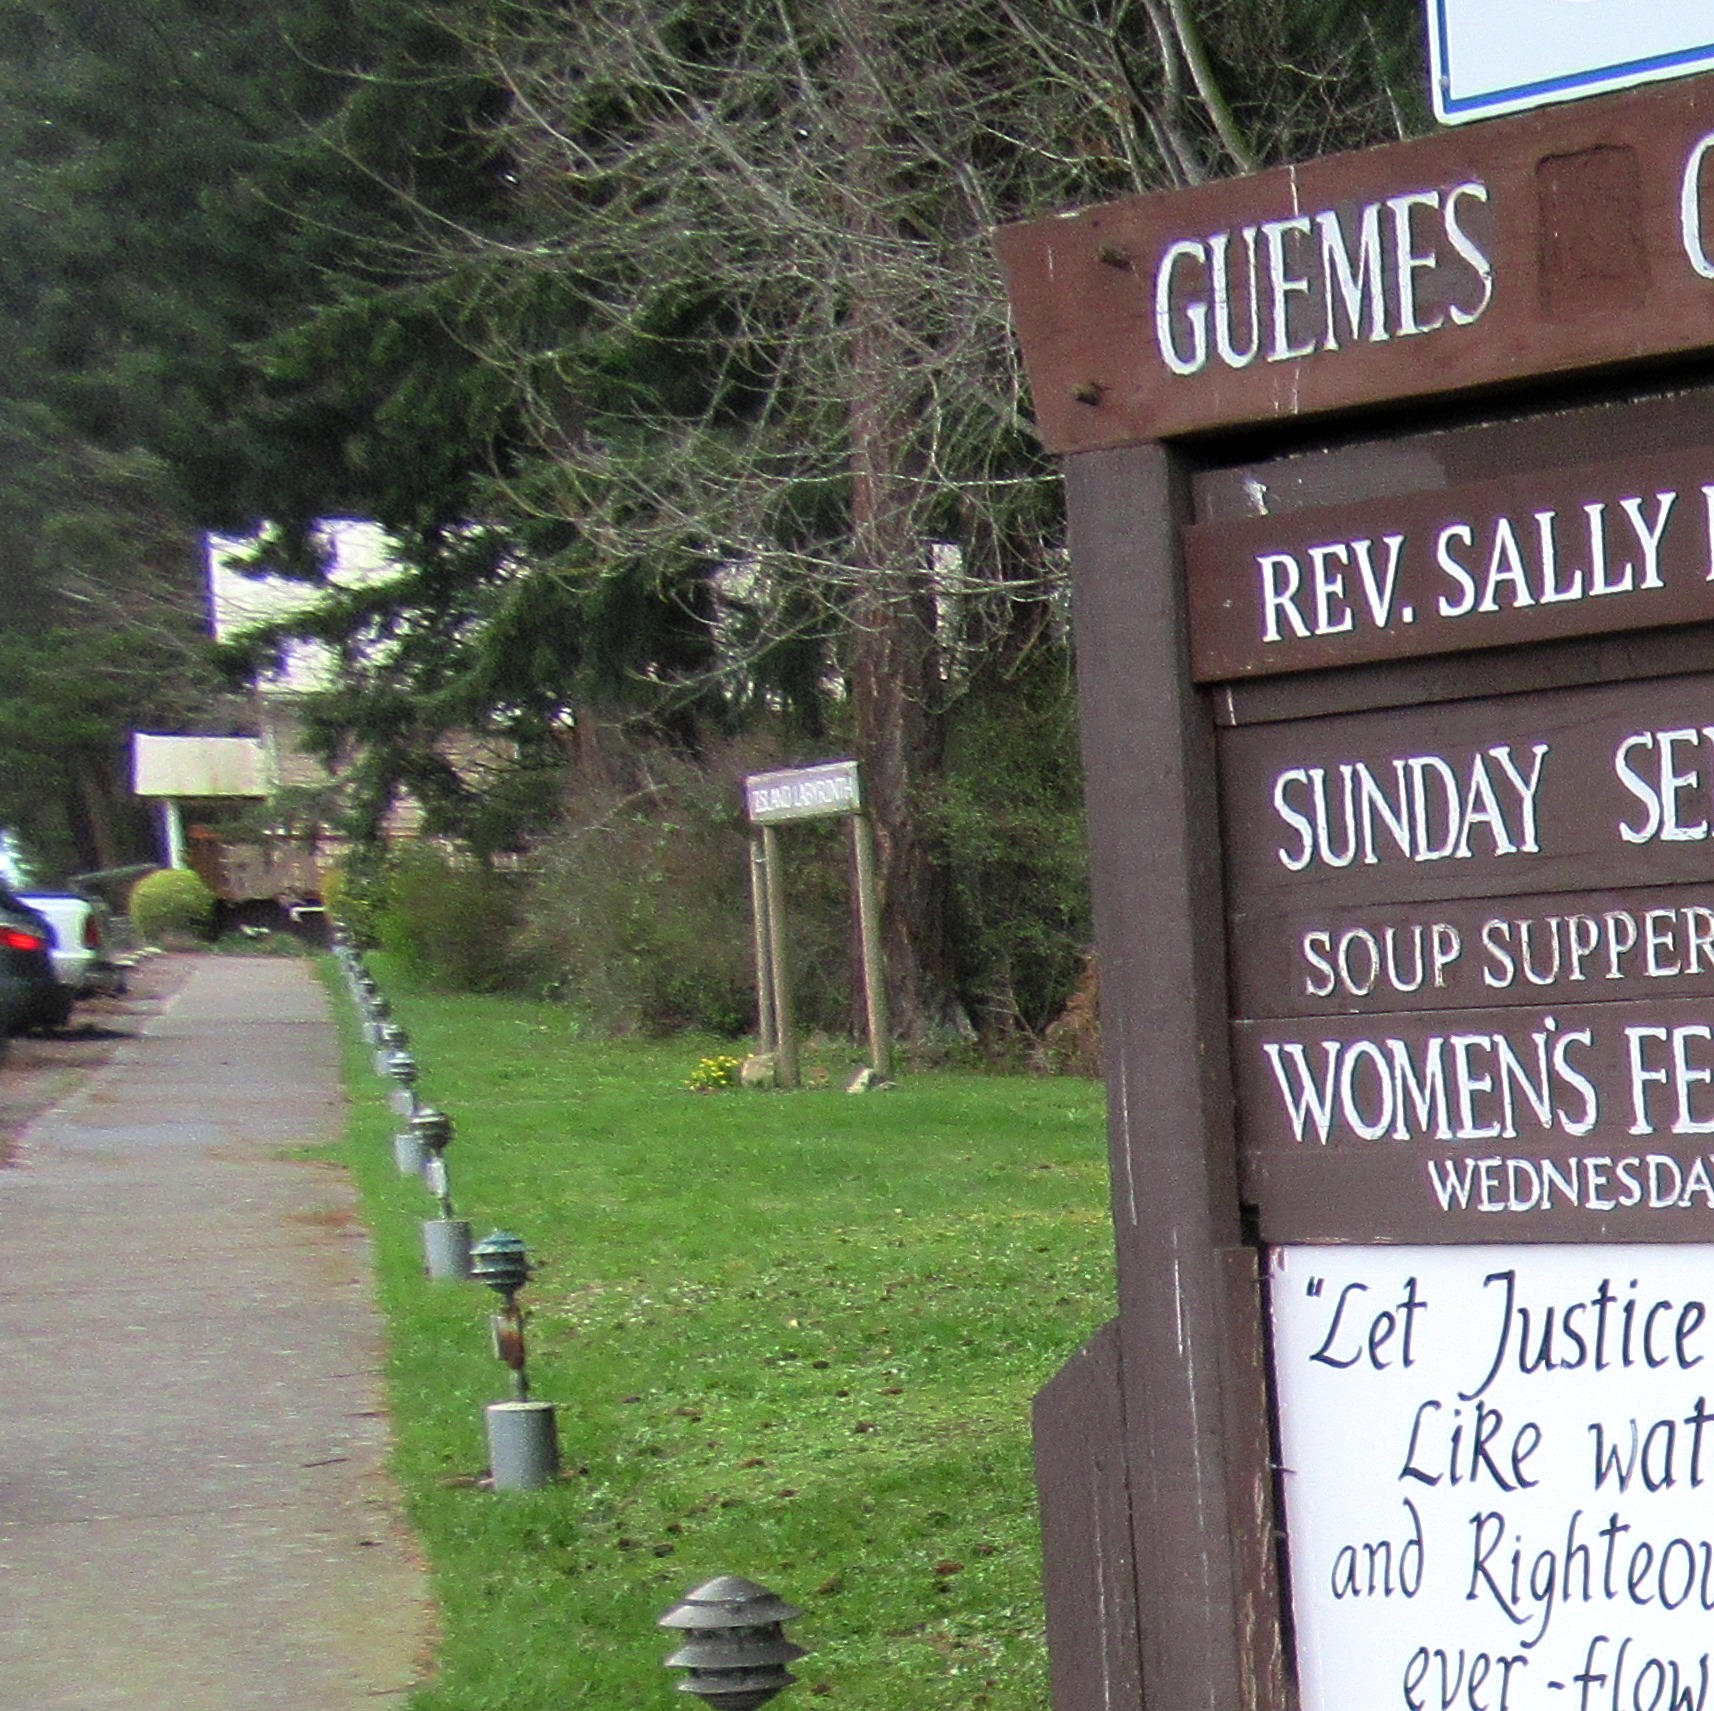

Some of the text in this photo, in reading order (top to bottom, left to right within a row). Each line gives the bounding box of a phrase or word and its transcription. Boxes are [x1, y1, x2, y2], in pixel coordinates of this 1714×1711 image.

[1156, 183, 1491, 374] GUEMES
[1257, 536, 1412, 642] REV.
[1437, 492, 1676, 616] SALLY
[1275, 745, 1548, 870] SUNDAY
[1304, 924, 1459, 996] SOUP
[1264, 1016, 1596, 1145] WOMEN'S
[1458, 1270, 1705, 1401] Justice
[1332, 1499, 1423, 1599] and
